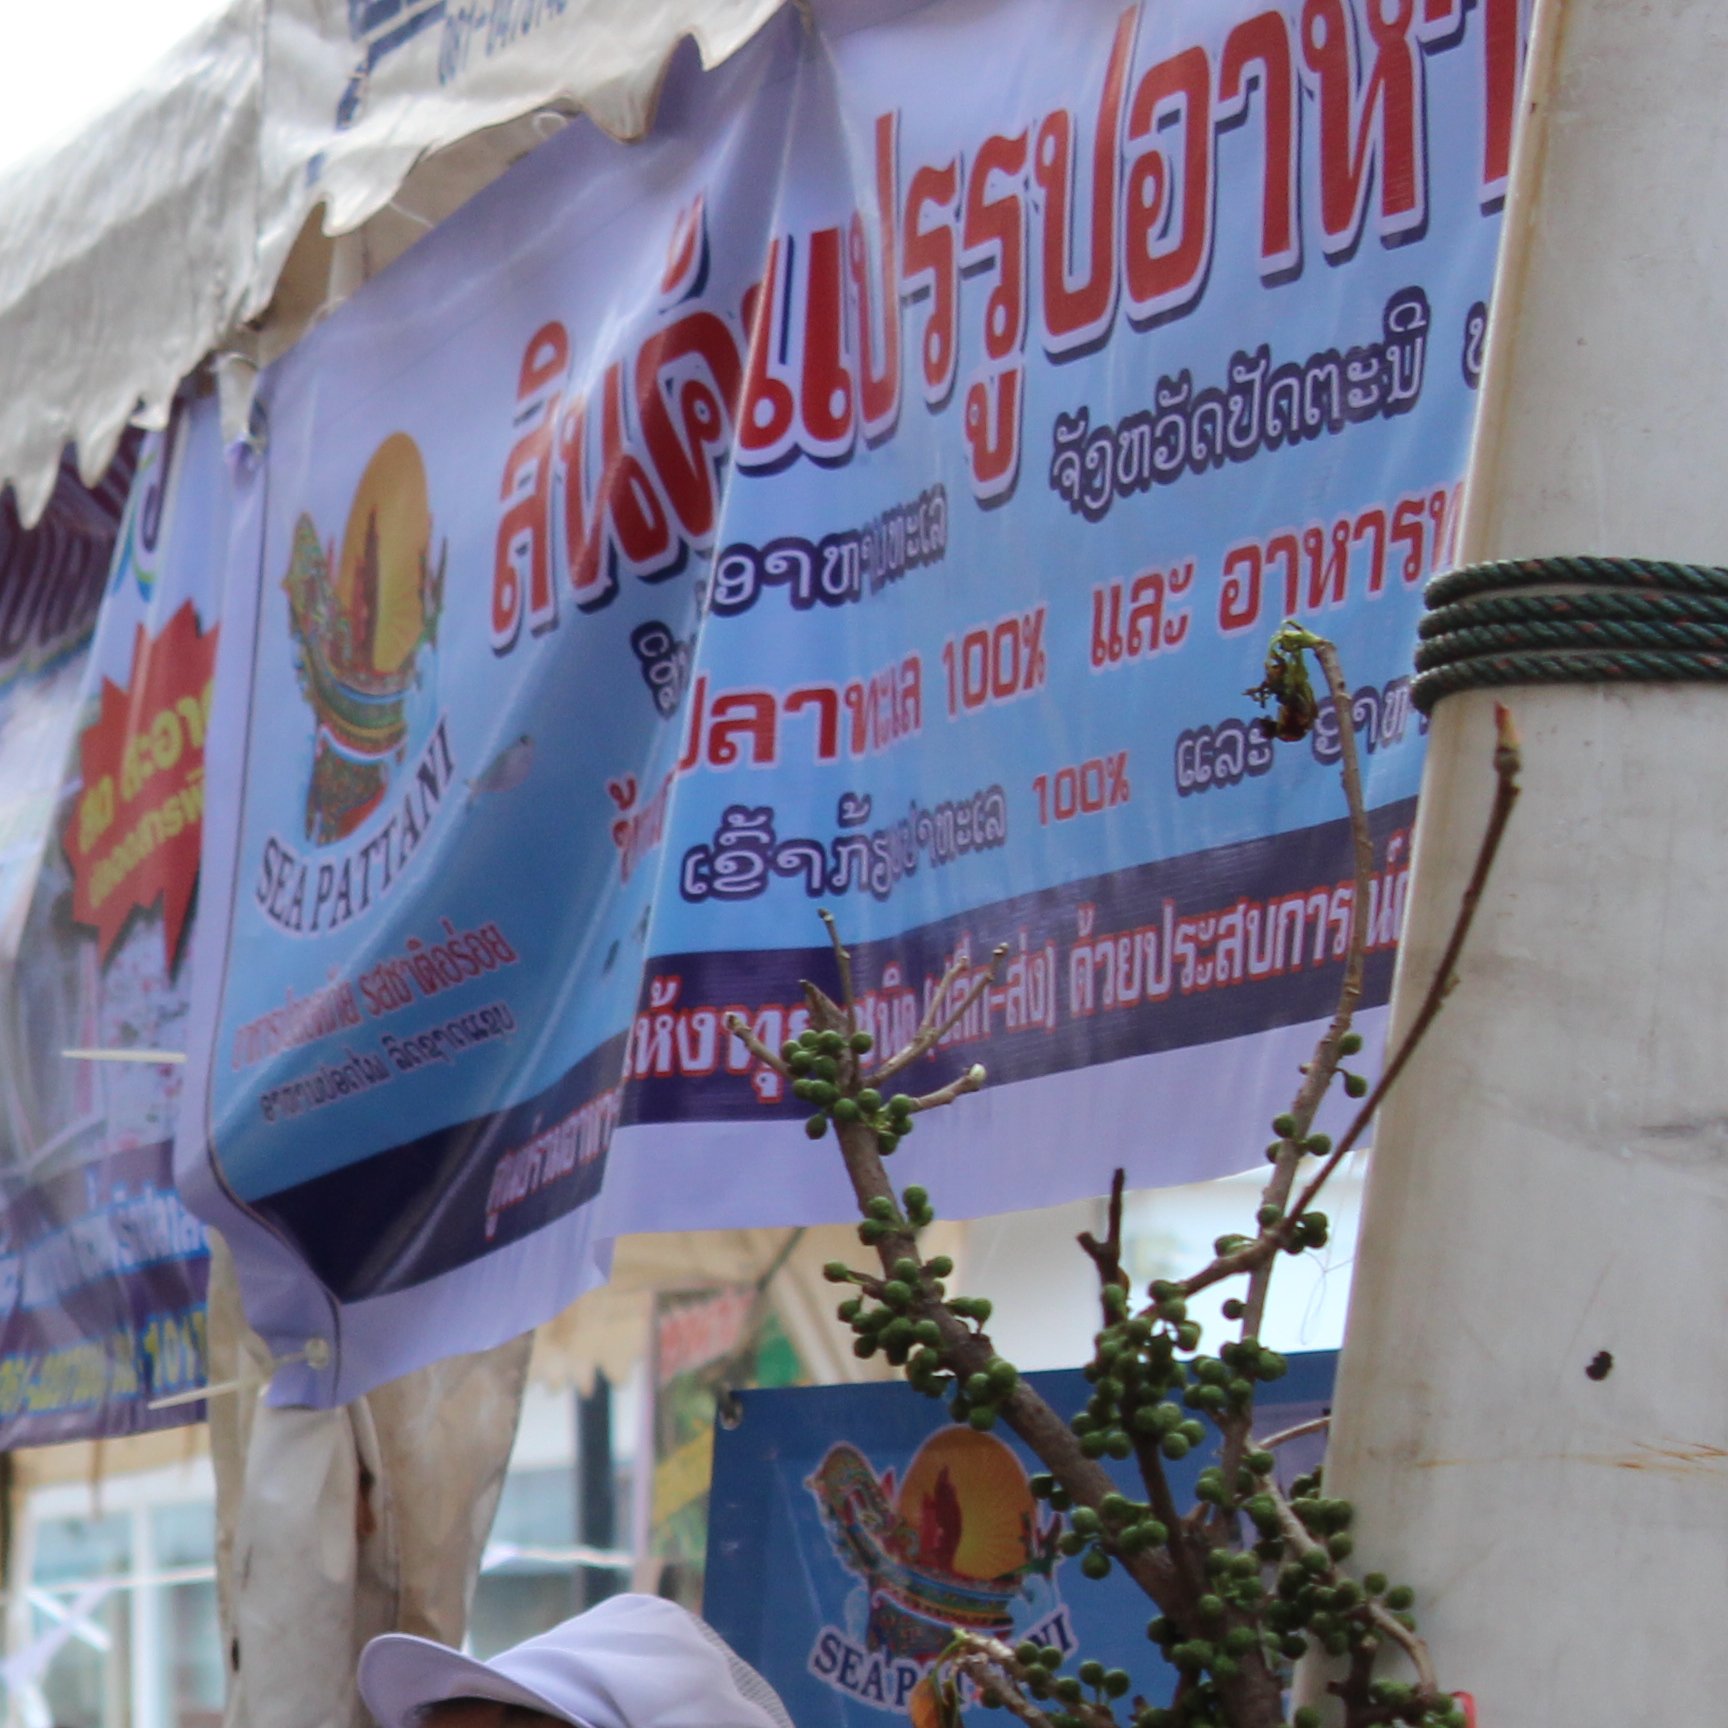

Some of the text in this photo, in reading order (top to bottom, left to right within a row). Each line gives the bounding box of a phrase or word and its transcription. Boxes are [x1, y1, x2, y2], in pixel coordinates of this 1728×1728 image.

[941, 607, 1046, 714] 100%
[1090, 562, 1194, 668] และ
[255, 836, 309, 932] SEA
[309, 720, 456, 933] PATTANI
[1031, 751, 1130, 826] 100%
[813, 1633, 885, 1701] SEA
